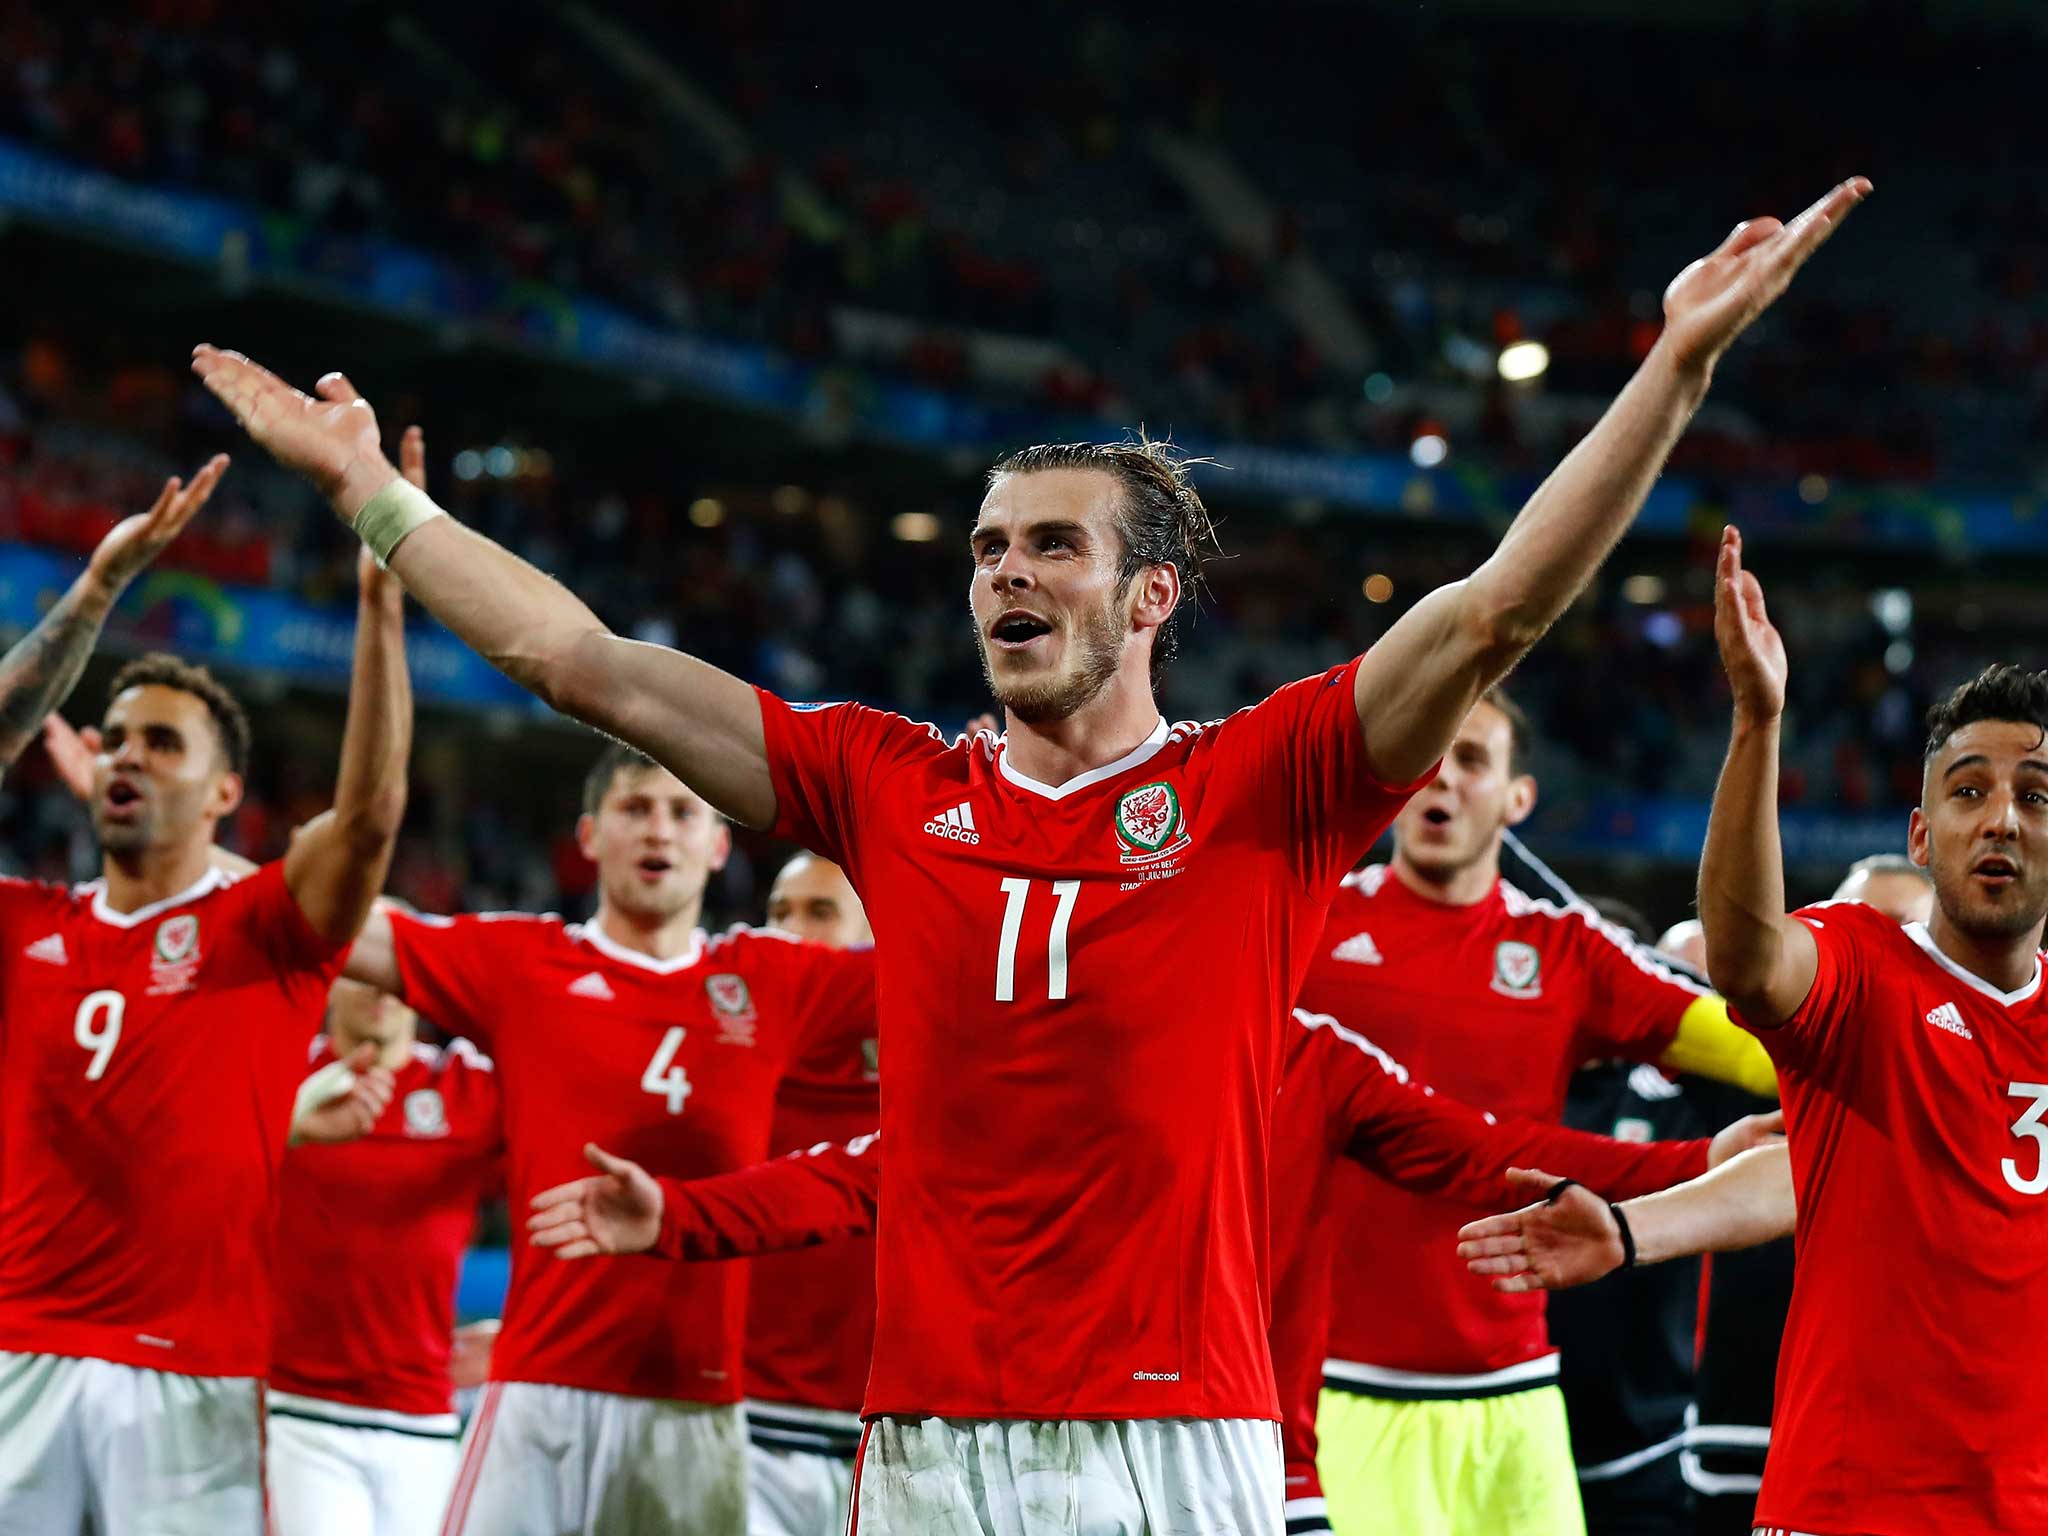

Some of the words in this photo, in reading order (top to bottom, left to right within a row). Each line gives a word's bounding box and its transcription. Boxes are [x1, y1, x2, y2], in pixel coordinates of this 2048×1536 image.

[923, 821, 980, 845] adidas
[995, 877, 1081, 1001] 11
[74, 990, 126, 1081] 9
[641, 1026, 693, 1115] 4
[1926, 1012, 1973, 1040] adidas
[2000, 1081, 2048, 1195] 3
[1132, 1370, 1180, 1381] climacool
